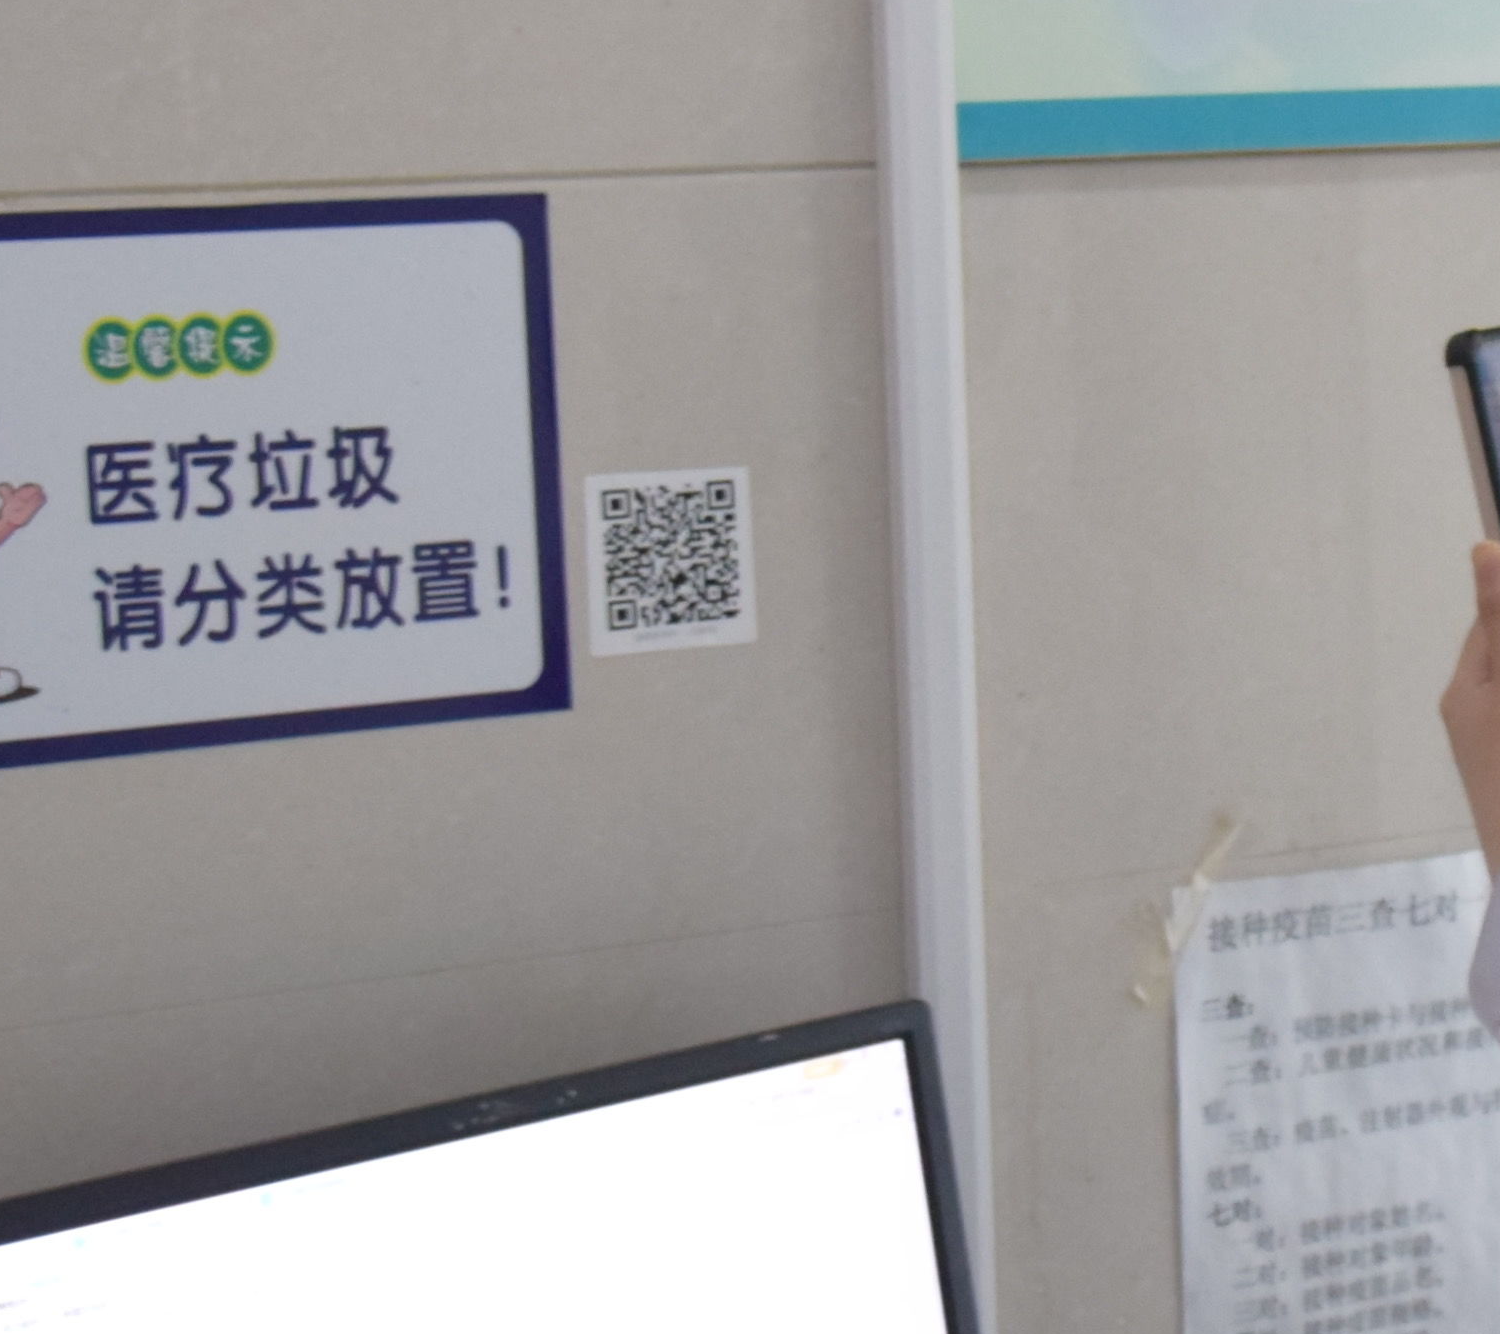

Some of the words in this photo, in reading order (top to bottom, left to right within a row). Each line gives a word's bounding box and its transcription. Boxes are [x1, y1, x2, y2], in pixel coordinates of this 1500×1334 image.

[86, 426, 399, 525] 医疗垃圾
[93, 539, 511, 652] 请分类放置！
[1208, 888, 1458, 953] 接种疫苗三查七对
